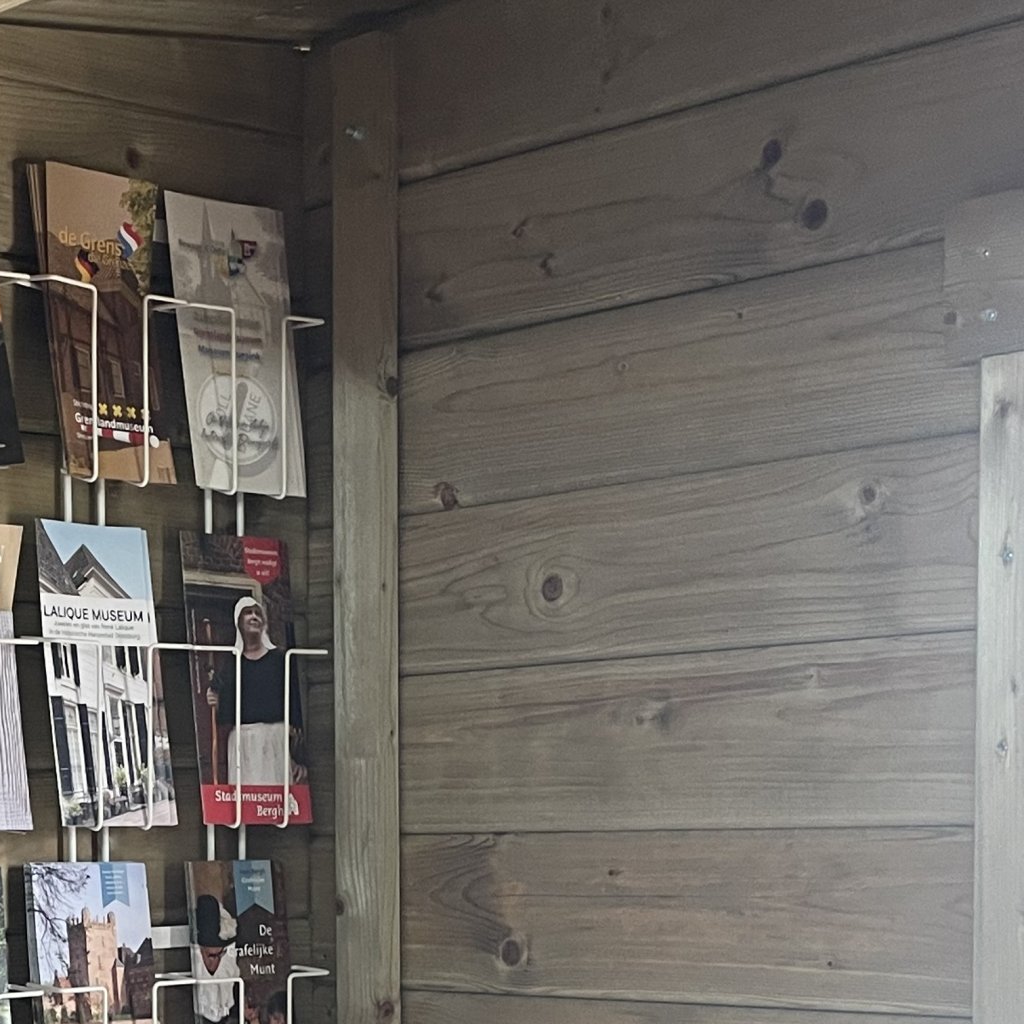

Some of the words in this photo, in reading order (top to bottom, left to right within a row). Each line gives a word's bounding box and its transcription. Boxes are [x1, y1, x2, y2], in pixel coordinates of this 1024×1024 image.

[58, 225, 76, 247] de
[79, 231, 126, 257] Grens
[43, 604, 89, 620] LALIQUE
[91, 608, 144, 623] MUSEUM
[214, 789, 283, 802] Stadmuseum
[256, 804, 284, 820] Bergh
[258, 924, 273, 937] De
[249, 963, 276, 976] Munt
